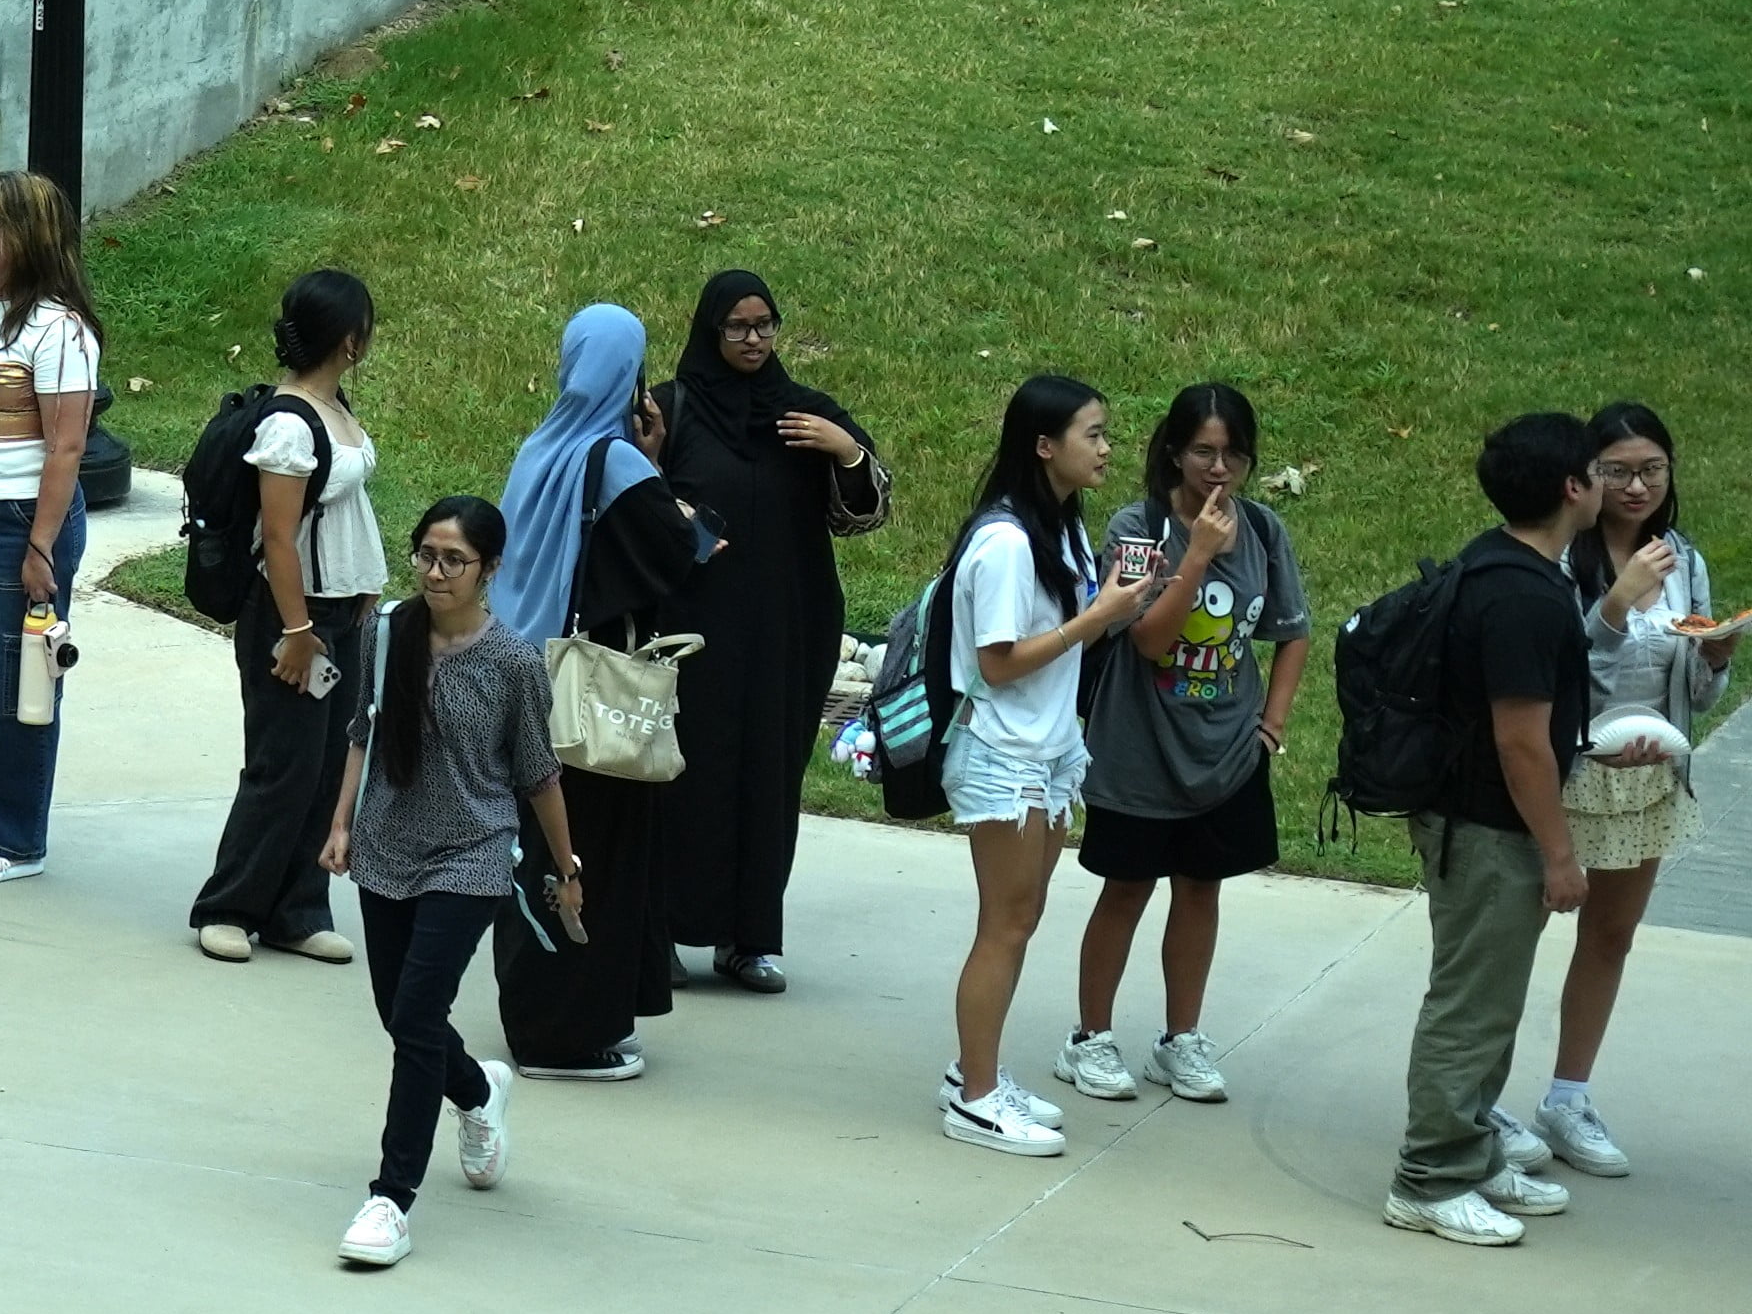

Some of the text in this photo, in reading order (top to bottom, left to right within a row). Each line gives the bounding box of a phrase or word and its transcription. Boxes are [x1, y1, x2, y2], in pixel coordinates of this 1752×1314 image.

[595, 702, 673, 735] TOTE G
[638, 696, 665, 716] TH
